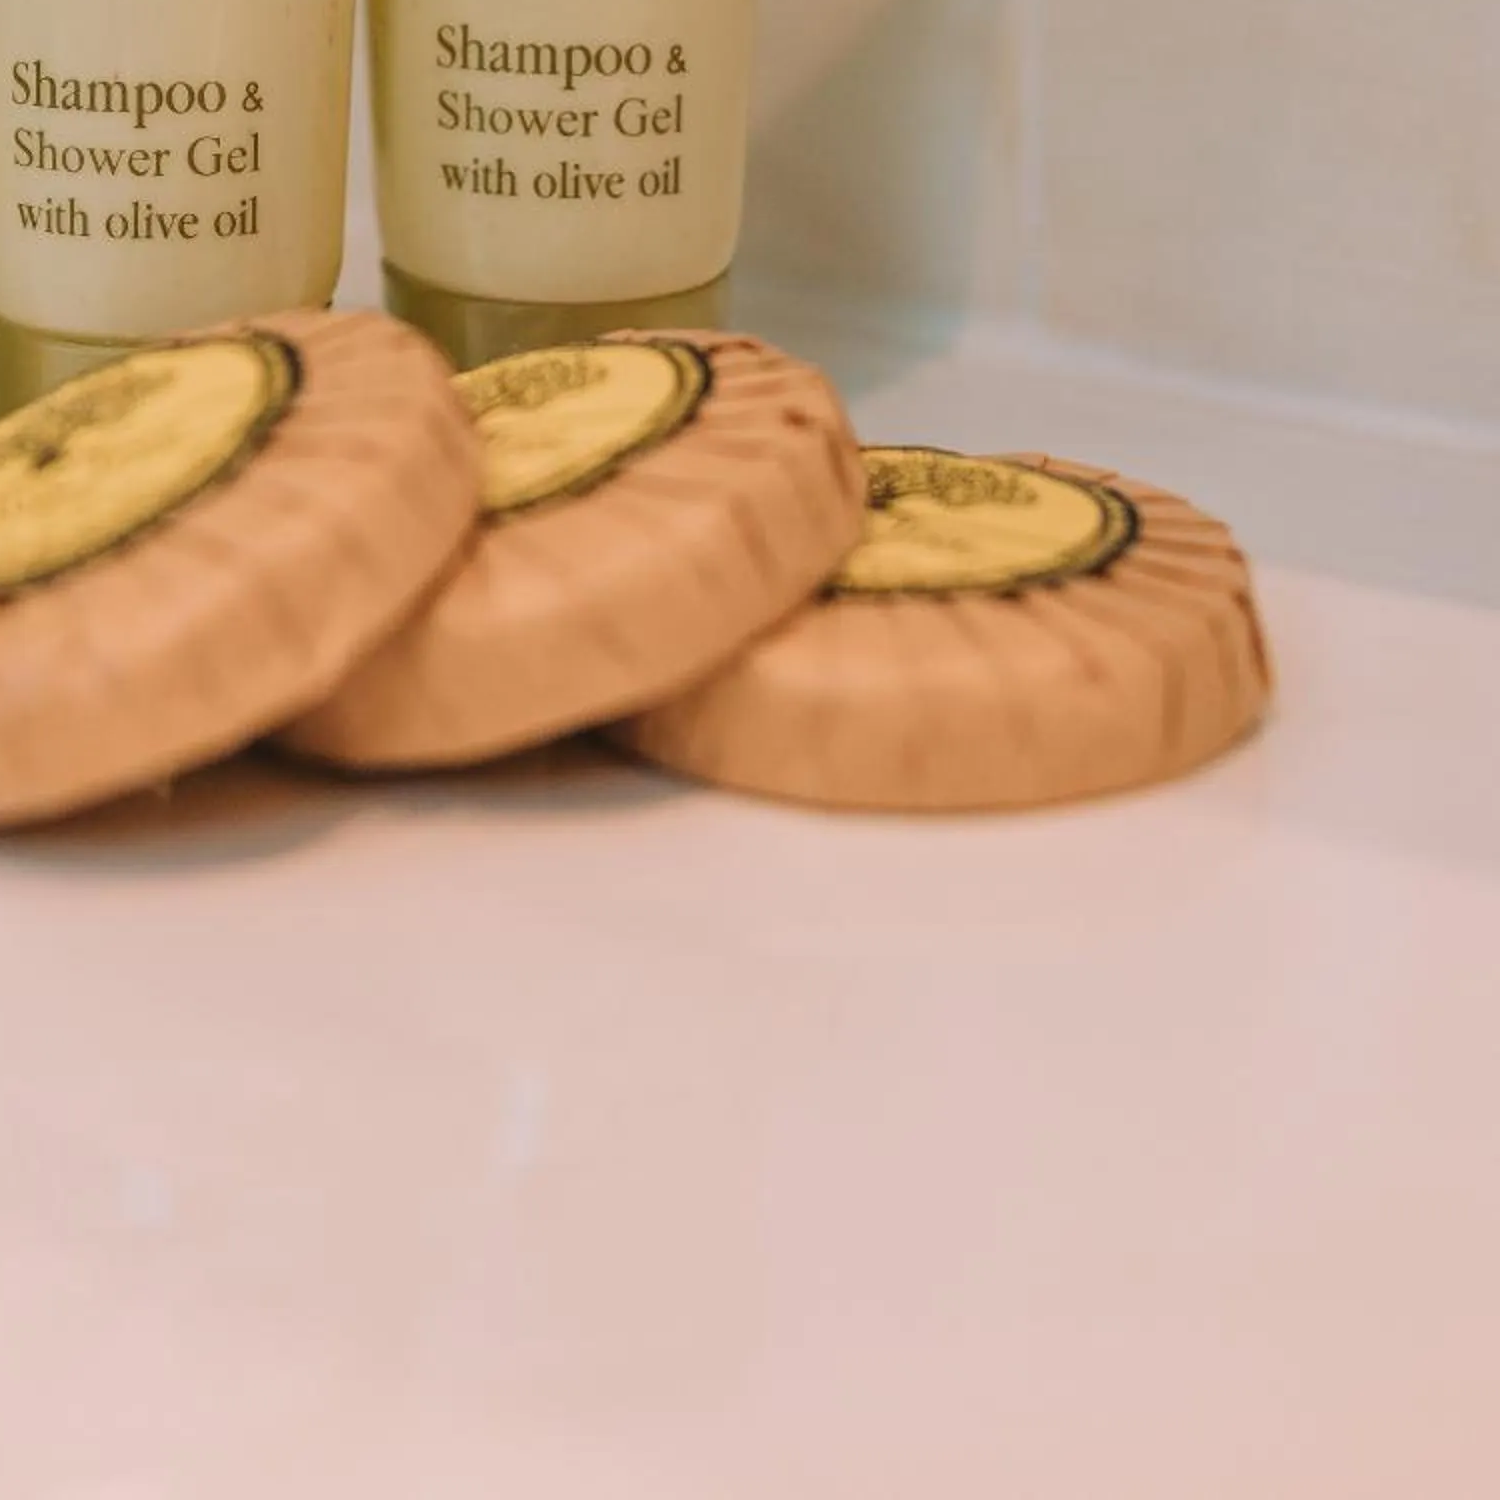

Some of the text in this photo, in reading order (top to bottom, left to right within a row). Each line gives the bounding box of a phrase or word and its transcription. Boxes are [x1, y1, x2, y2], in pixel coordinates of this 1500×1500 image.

[435, 23, 687, 91] Shampoo &
[10, 59, 265, 129] Shampoo &
[437, 89, 684, 138] Shower Gel
[13, 127, 262, 178] Shower Gel
[439, 156, 682, 200] with olive oil
[17, 195, 260, 239] with olive oil
